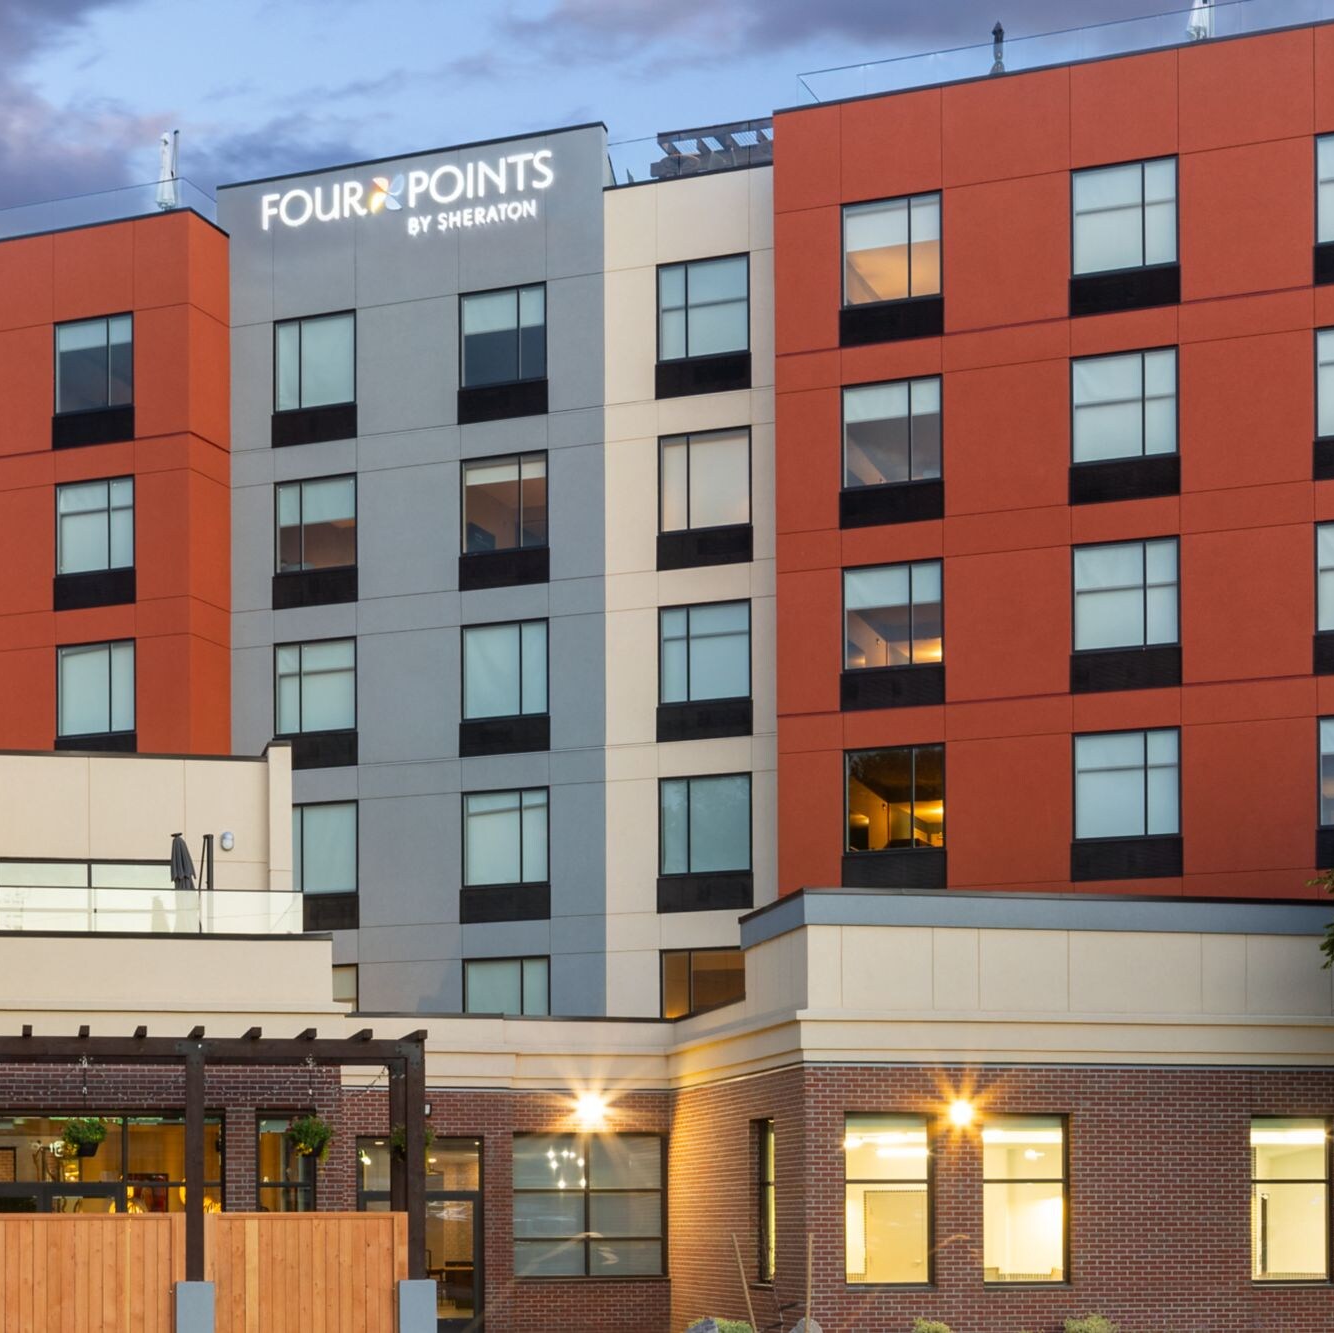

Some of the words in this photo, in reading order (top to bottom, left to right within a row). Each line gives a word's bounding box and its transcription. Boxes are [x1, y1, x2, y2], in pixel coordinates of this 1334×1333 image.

[261, 180, 367, 231] FOUR
[407, 149, 555, 208] POINTS
[407, 215, 430, 236] BY
[436, 199, 538, 231] SHERATON
